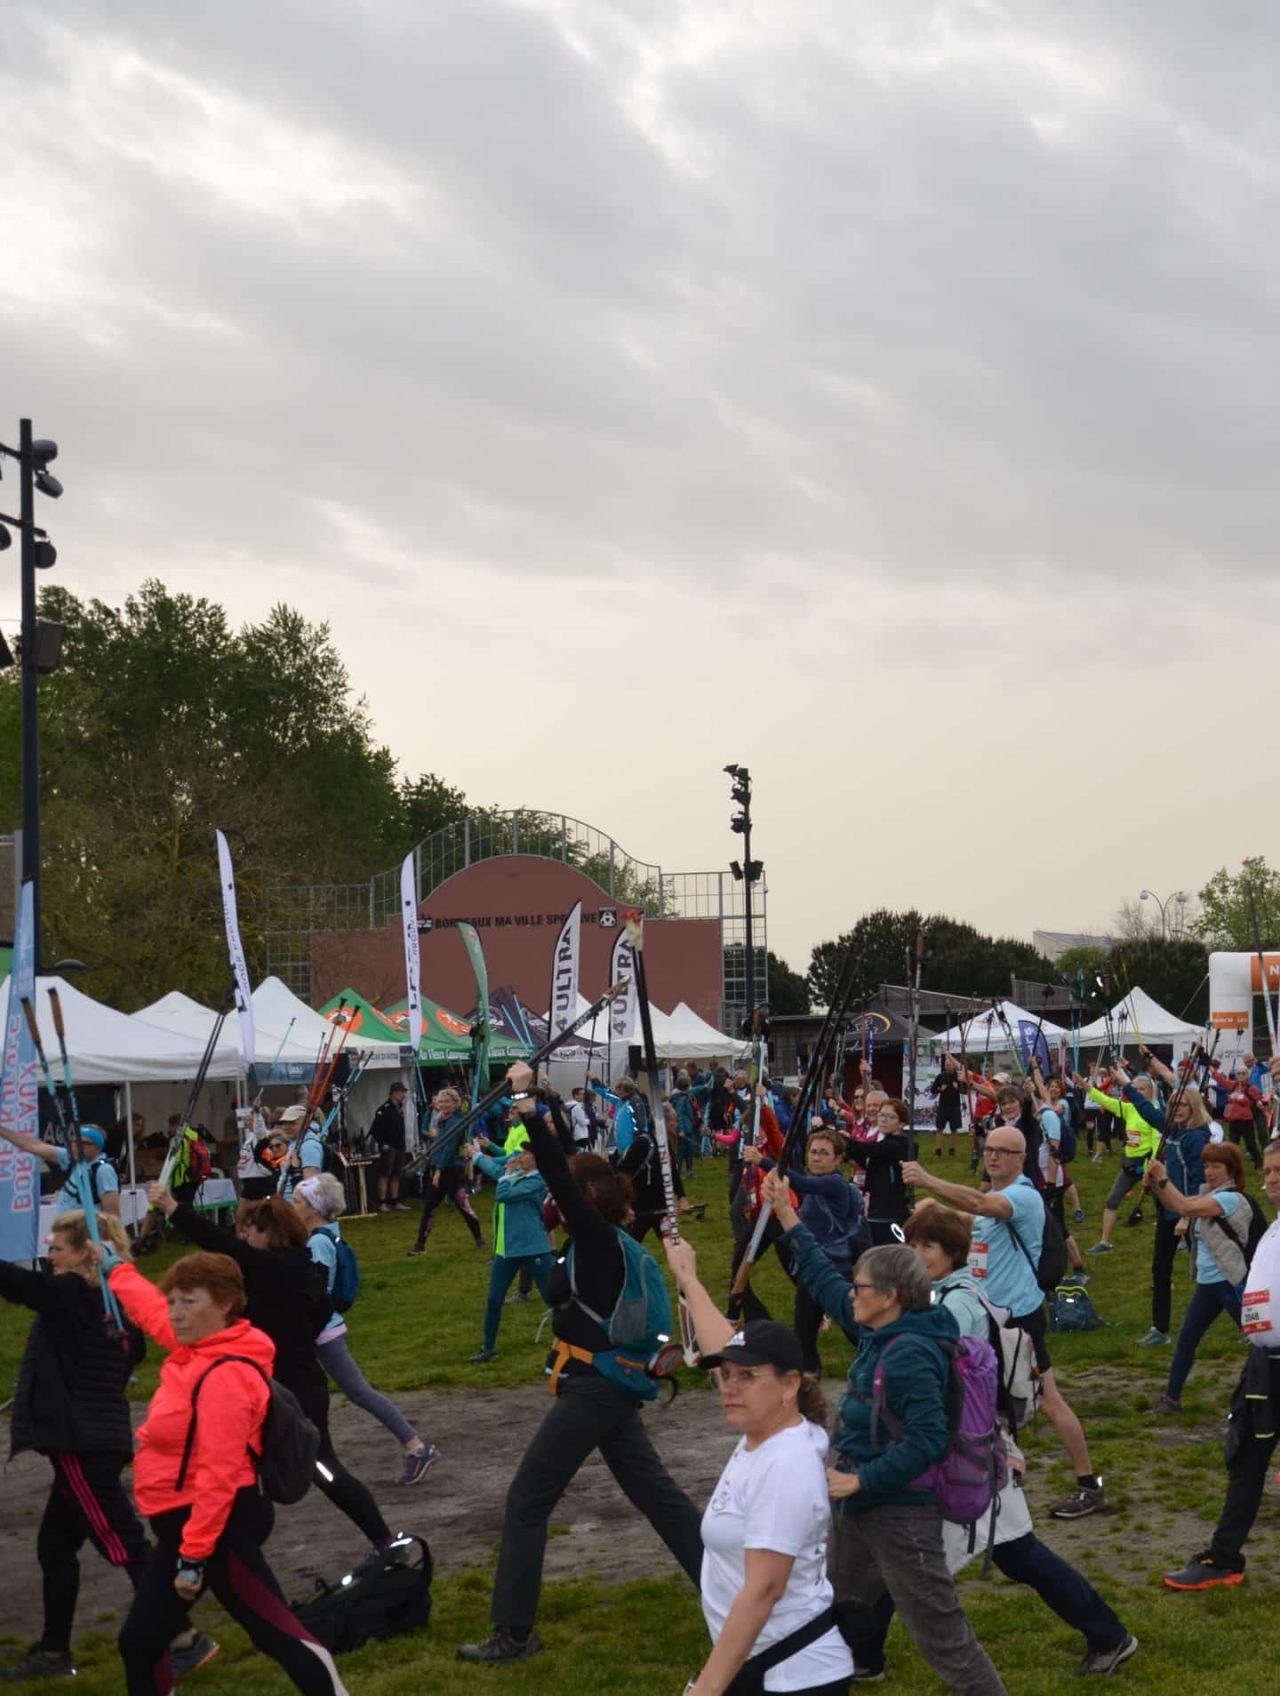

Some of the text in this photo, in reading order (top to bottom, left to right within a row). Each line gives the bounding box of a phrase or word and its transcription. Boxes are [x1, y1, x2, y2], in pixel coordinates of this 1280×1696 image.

[495, 915, 512, 927] MA
[515, 914, 543, 926] VILLE
[546, 913, 597, 925] SPOIVE
